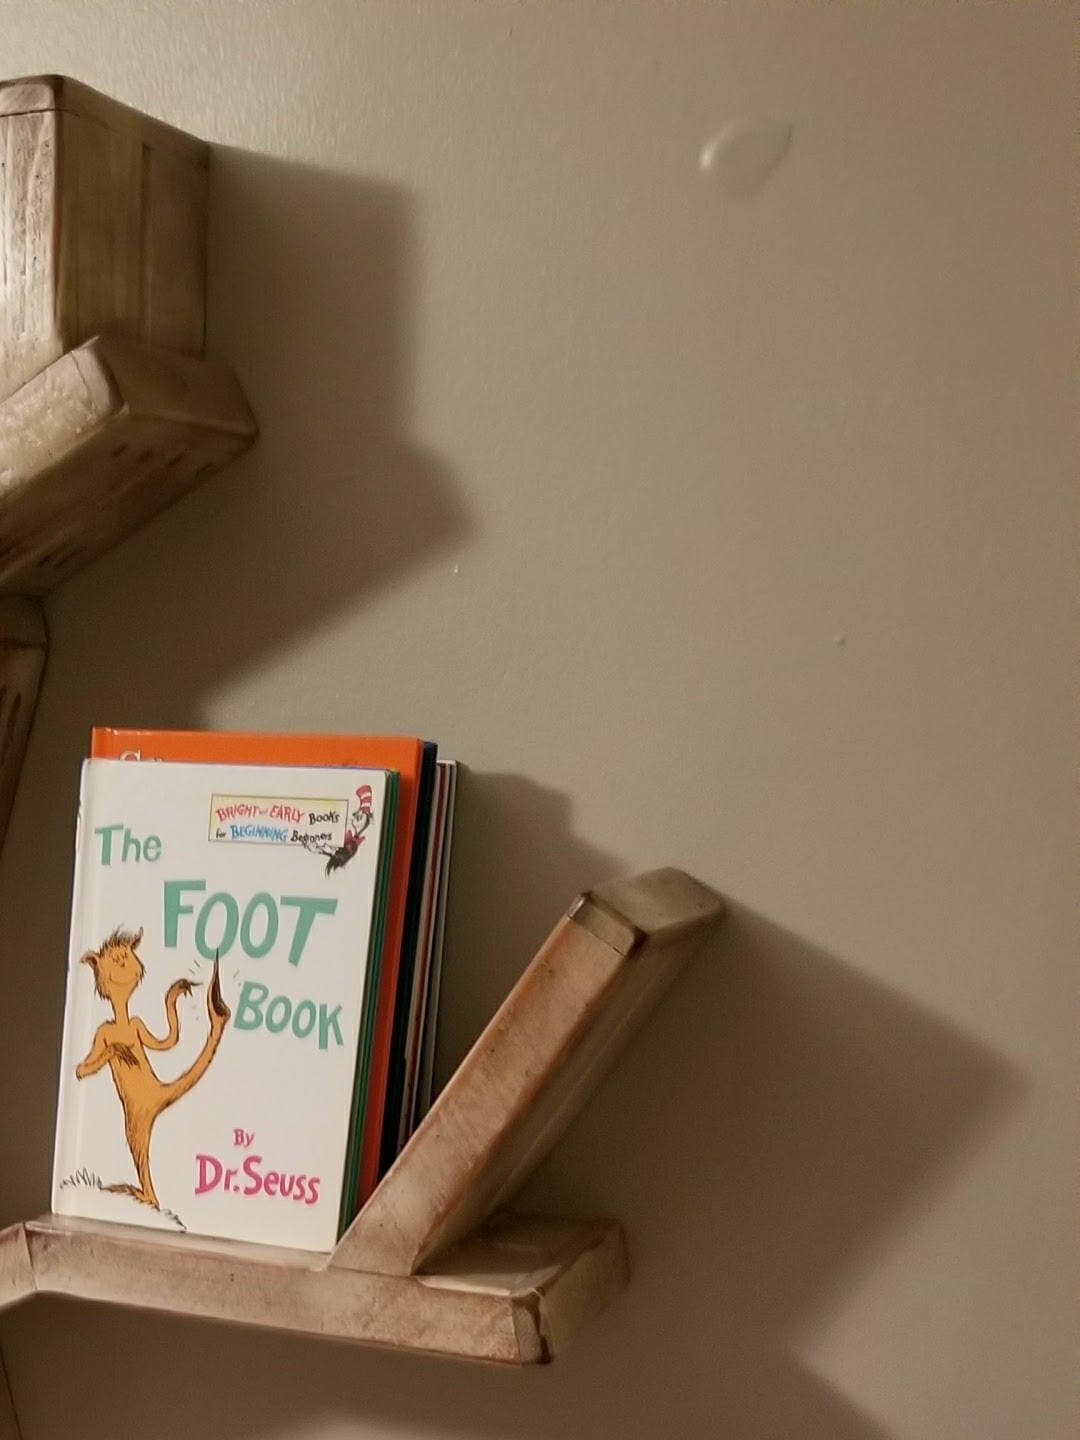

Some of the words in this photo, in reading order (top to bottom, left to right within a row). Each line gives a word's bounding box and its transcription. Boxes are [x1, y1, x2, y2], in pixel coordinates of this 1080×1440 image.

[216, 803, 259, 822] BRIGHT
[269, 802, 305, 823] EARLY
[308, 810, 340, 825] Books
[95, 824, 162, 866] The
[230, 824, 289, 842] BEGINNING
[163, 879, 337, 967] FOOT
[233, 981, 344, 1050] BOOK
[232, 1128, 255, 1149] By
